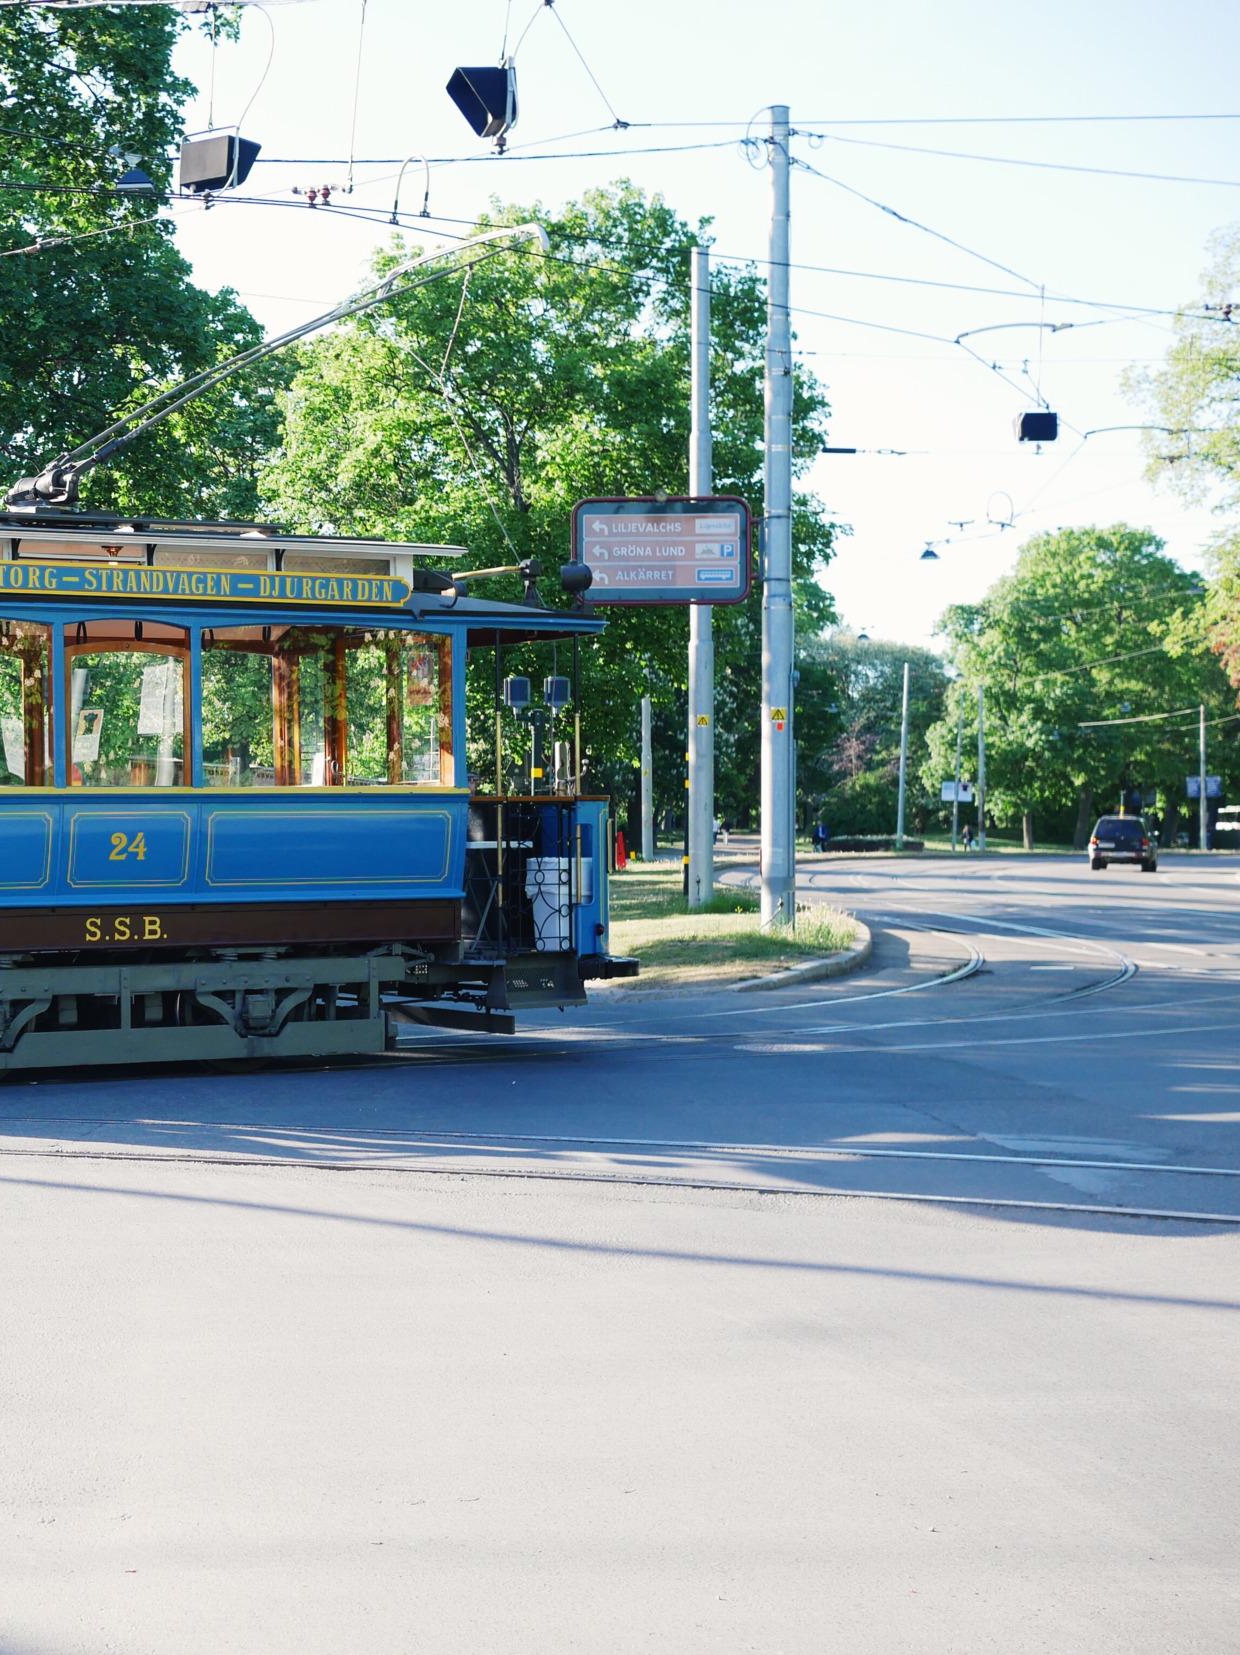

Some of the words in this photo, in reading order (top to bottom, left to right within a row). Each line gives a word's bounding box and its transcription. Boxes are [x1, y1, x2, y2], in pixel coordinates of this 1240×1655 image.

[612, 522, 682, 533] LILJEVALCHS
[613, 545, 652, 557] GRÖNA
[656, 546, 686, 557] LUND
[616, 568, 674, 581] ALKÄRRET
[109, 831, 147, 861] 24
[85, 916, 168, 942] S.S.B.
